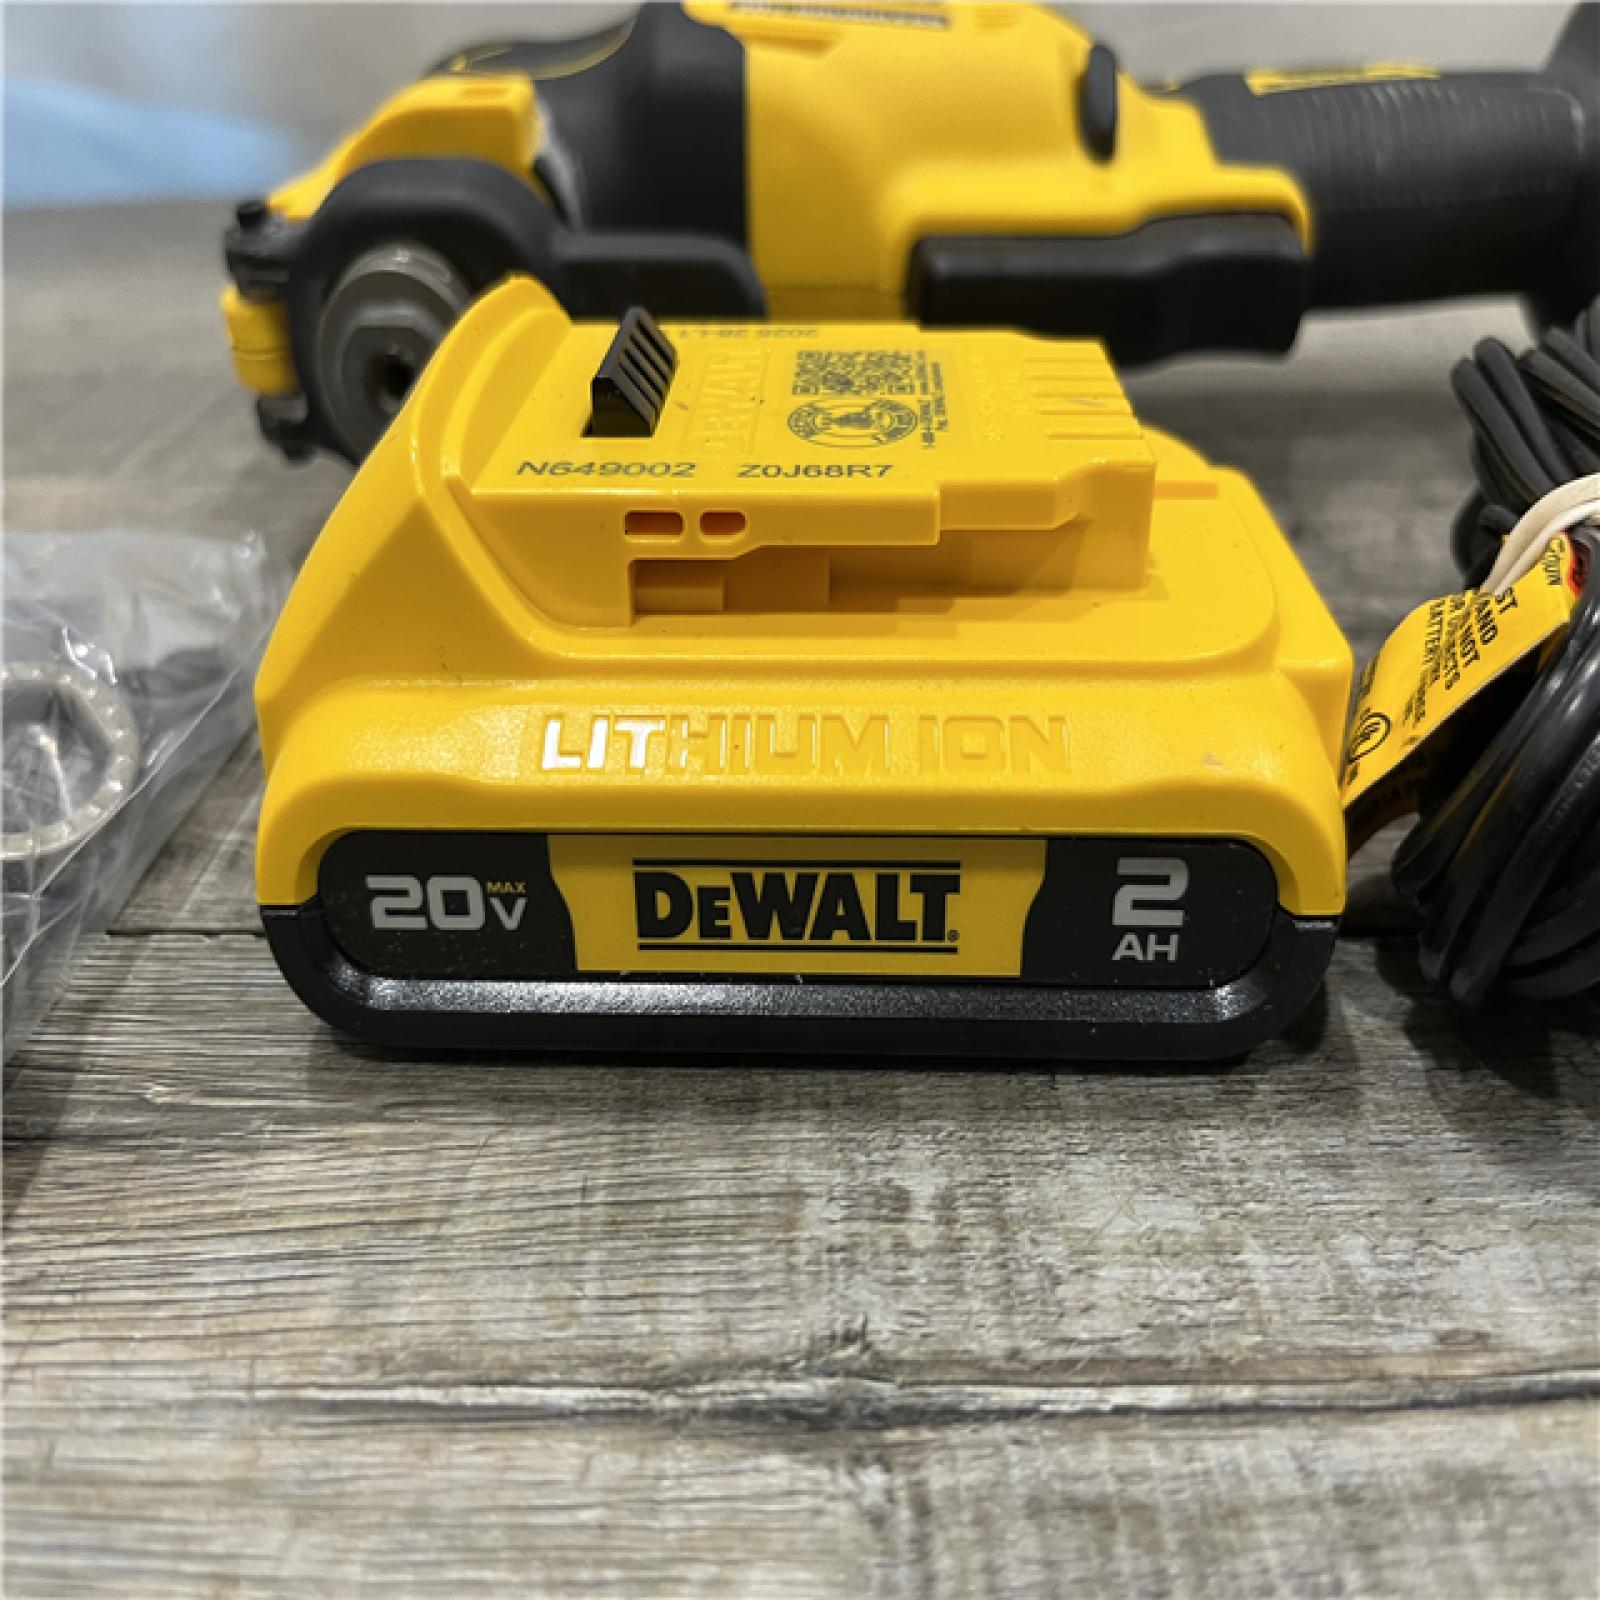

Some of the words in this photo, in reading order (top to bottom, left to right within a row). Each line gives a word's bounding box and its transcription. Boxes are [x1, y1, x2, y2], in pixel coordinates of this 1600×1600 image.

[516, 461, 697, 478] N649002
[541, 714, 893, 775] LITHIUM
[918, 714, 1071, 775] ION
[486, 881, 527, 894] MAX
[1112, 857, 1189, 927] 2
[1112, 934, 1179, 962] AH
